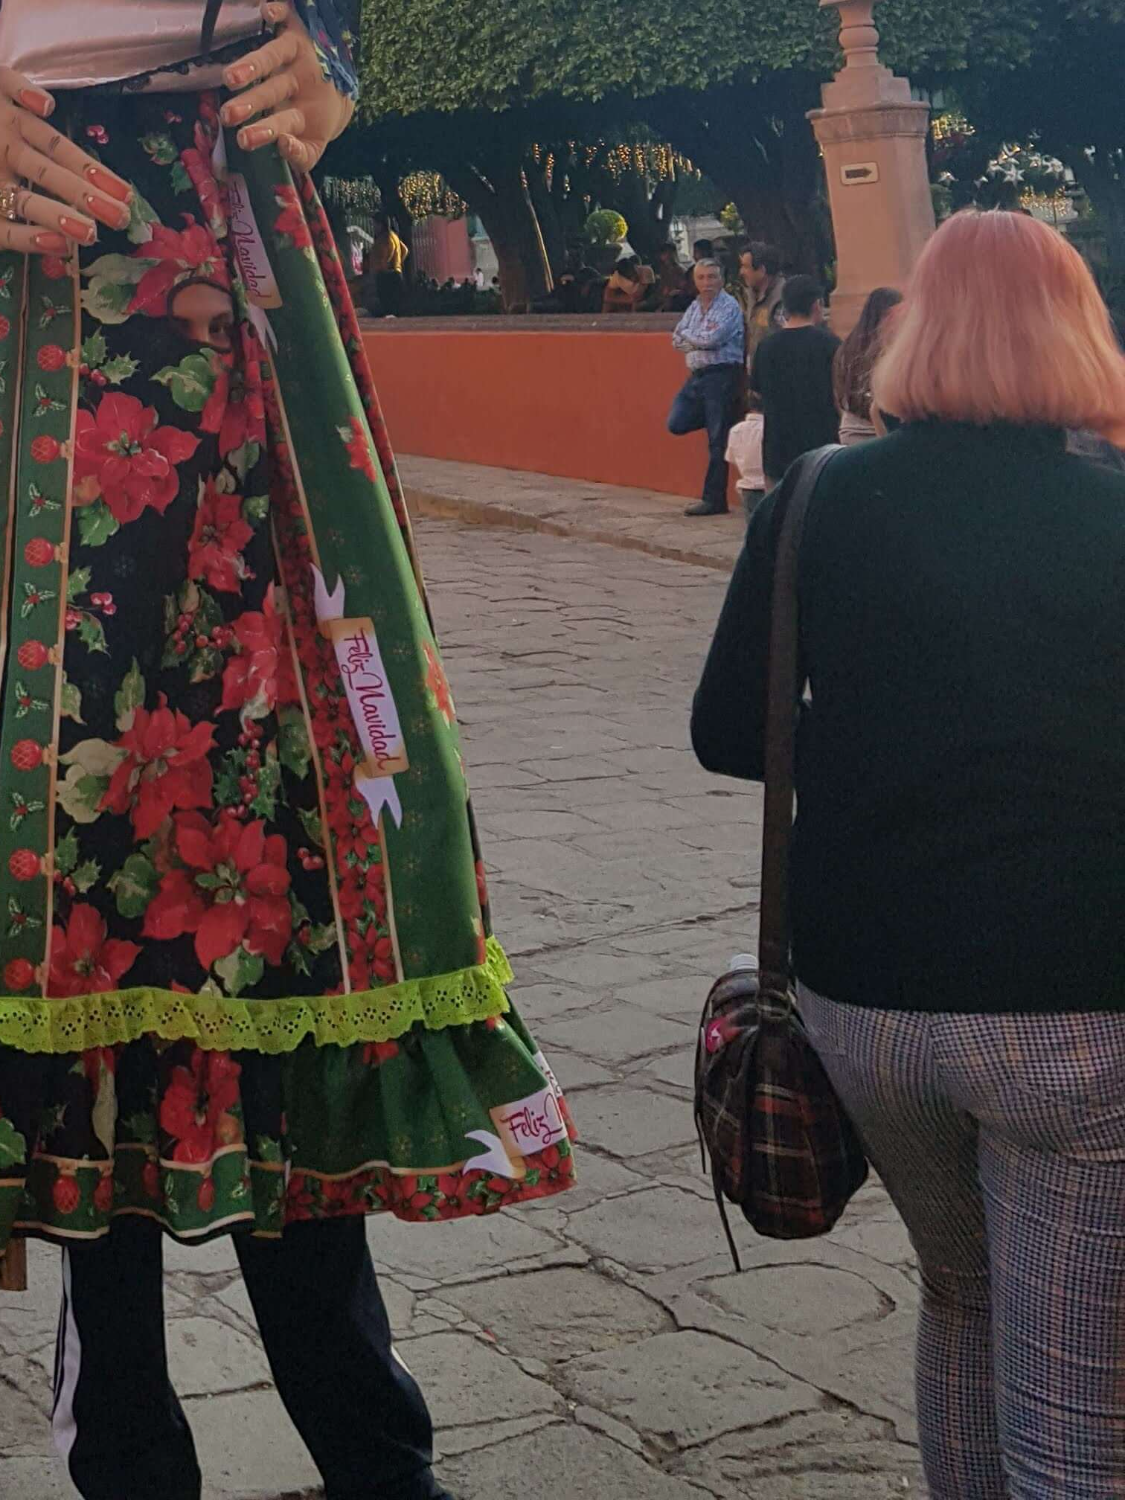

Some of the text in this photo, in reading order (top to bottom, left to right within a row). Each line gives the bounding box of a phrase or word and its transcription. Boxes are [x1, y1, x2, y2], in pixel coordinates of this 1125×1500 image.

[232, 220, 272, 299] Navidad
[341, 627, 401, 771] Feliz Navidad
[499, 1106, 563, 1145] Feliz
